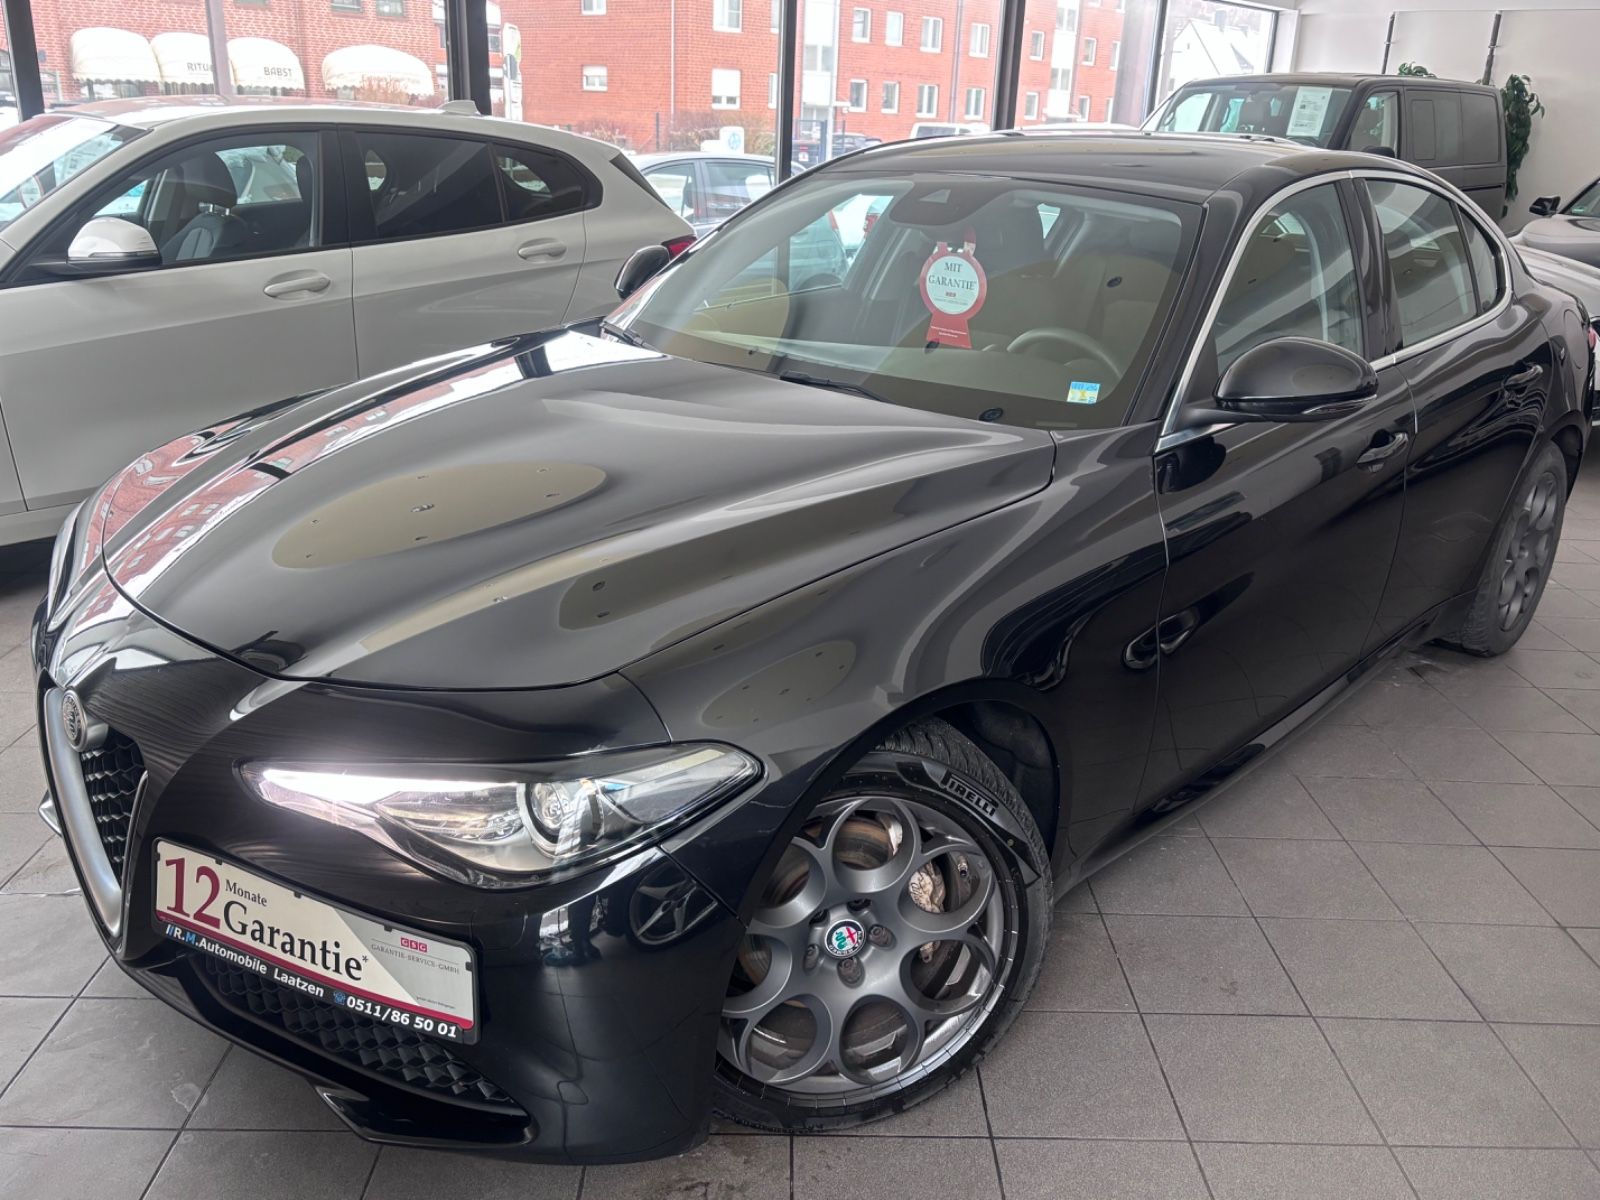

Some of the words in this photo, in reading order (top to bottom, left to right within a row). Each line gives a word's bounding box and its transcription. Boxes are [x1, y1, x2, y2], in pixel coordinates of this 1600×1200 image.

[187, 62, 213, 72] RITU
[264, 66, 293, 77] BABST
[944, 262, 963, 273] MIT
[941, 769, 998, 817] PIRELLI
[165, 857, 222, 930] 12
[225, 878, 268, 907] Monate
[273, 967, 325, 998] Laatzen
[346, 995, 411, 1026] 0511/86
[413, 1015, 435, 1032] 50
[437, 1022, 457, 1038] 01
